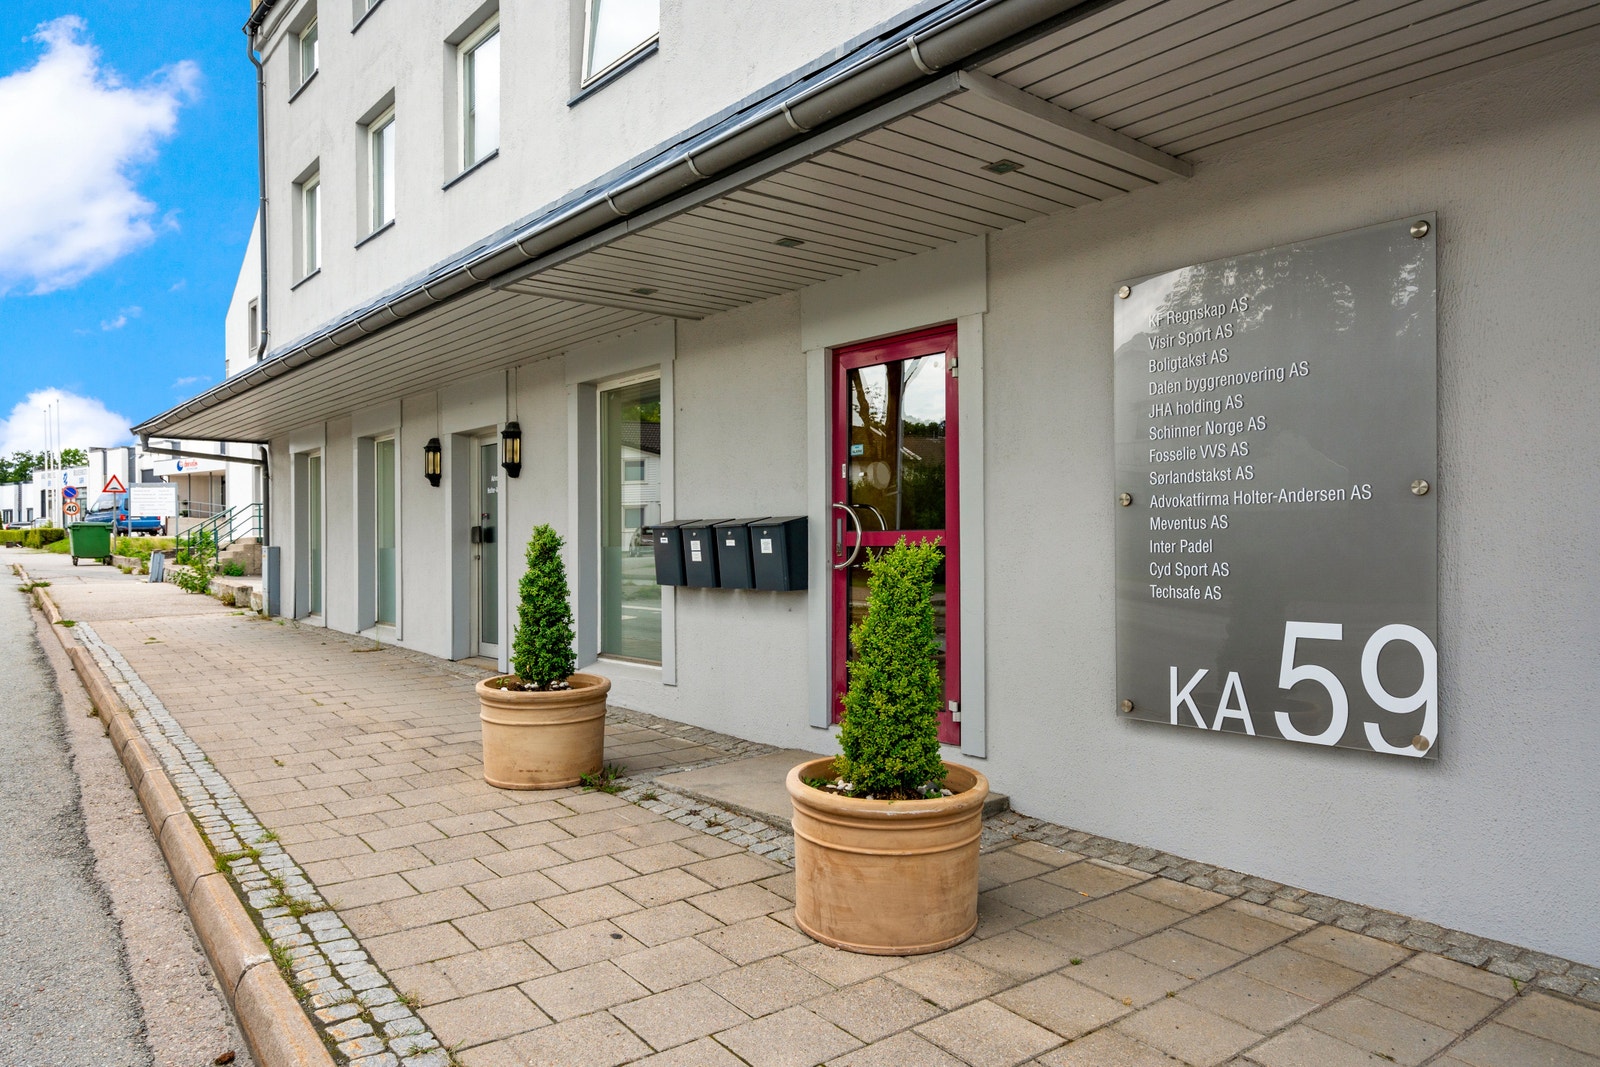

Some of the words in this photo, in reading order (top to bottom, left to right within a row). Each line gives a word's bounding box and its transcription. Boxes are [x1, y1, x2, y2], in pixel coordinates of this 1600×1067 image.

[1149, 313, 1165, 327] KF
[1168, 302, 1227, 325] Regnskap
[1230, 296, 1249, 313] AS
[1149, 335, 1175, 350] Visir
[1178, 328, 1212, 346] Sport
[1216, 323, 1233, 339] AS
[1149, 353, 1207, 373] Boligtakst
[1210, 348, 1228, 364] AS
[1149, 379, 1181, 395] Dalen
[1185, 367, 1285, 393] byggrenovering
[1289, 361, 1309, 377] AS
[1149, 403, 1172, 419] JHA
[1176, 398, 1221, 416] holding
[1225, 394, 1244, 410] AS
[1149, 424, 1201, 440] Schinner
[1206, 420, 1243, 435] Norge
[1247, 416, 1266, 431] AS
[1150, 447, 1197, 462] Fosselie
[1200, 444, 1227, 459] VVS
[1230, 442, 1249, 456] AS
[1150, 468, 1231, 486] Sørlandstakst
[1236, 465, 1254, 480] AS
[66, 504, 77, 512] 40
[1150, 492, 1229, 509] Advokatfirma
[1234, 487, 1345, 505] Holter-Andersen
[1351, 484, 1372, 500] AS
[1150, 516, 1206, 530] Meventus
[1211, 515, 1228, 529] AS
[1150, 540, 1176, 553] Inter
[1180, 539, 1213, 553] Padel
[1150, 562, 1171, 580] Cyd
[1175, 563, 1208, 579] Sport
[1212, 563, 1229, 576] AS
[1150, 585, 1201, 599] Techsafe
[1204, 586, 1222, 600] AS
[1170, 666, 1255, 736] KA
[1274, 621, 1438, 757] 59
